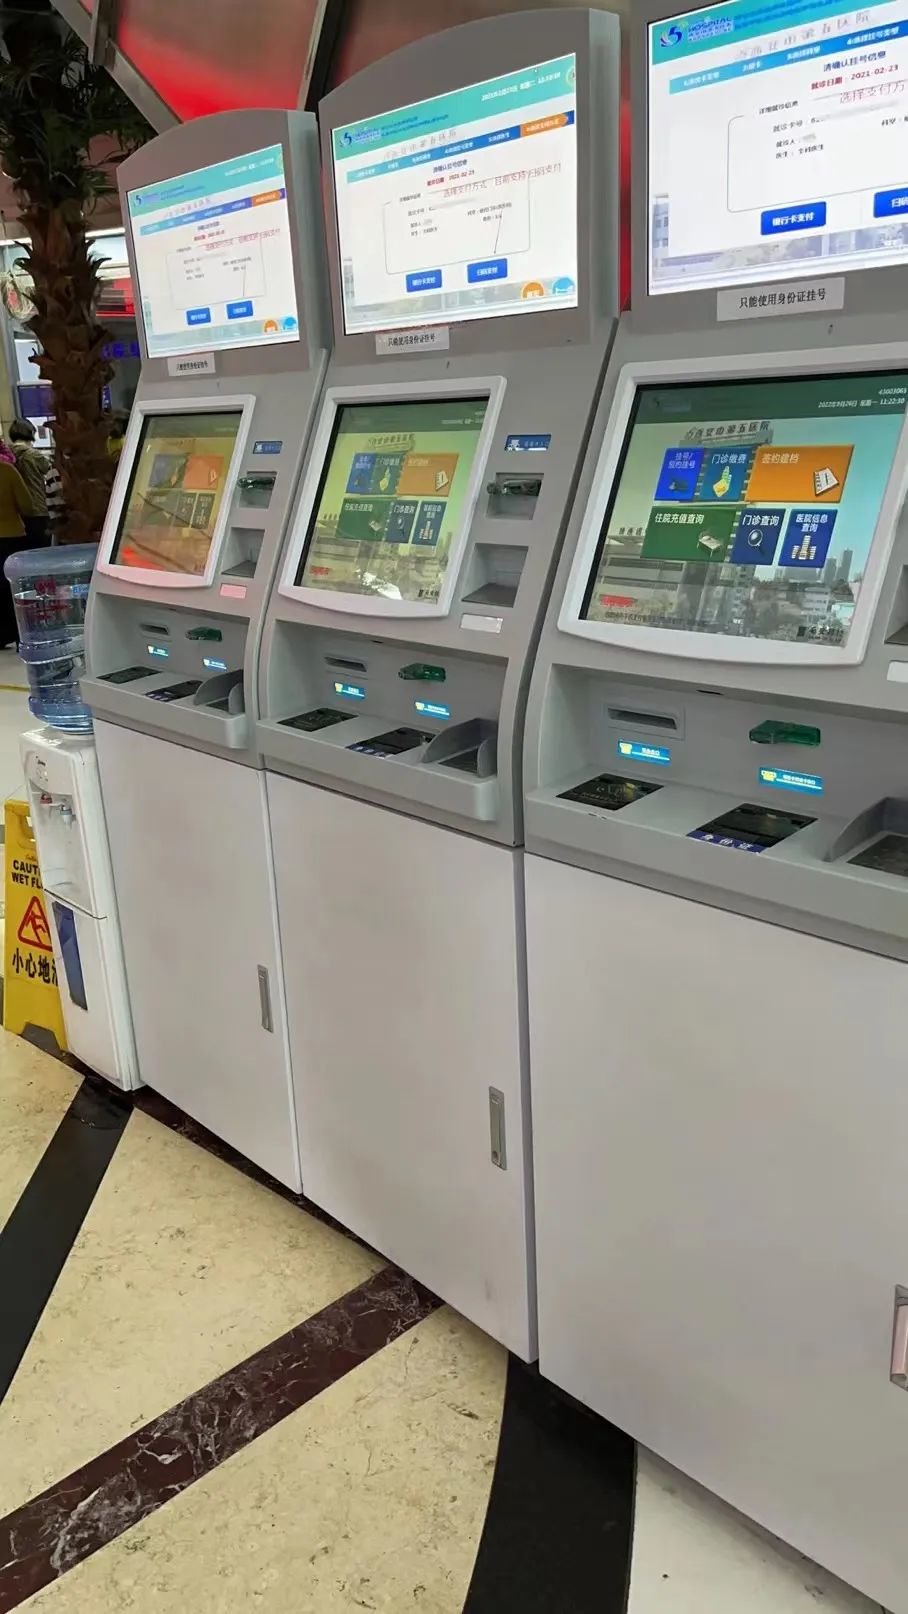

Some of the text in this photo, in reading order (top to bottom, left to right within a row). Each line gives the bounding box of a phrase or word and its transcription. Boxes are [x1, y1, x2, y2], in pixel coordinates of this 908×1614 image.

[740, 287, 826, 309] 只能使用身份证挂号
[711, 453, 747, 465] 门诊缴费
[655, 513, 704, 525] 住院充值查询
[741, 515, 780, 527] 门诊查询
[796, 513, 828, 524] 医院信息
[801, 523, 819, 533] 查询
[11, 872, 29, 887] WET
